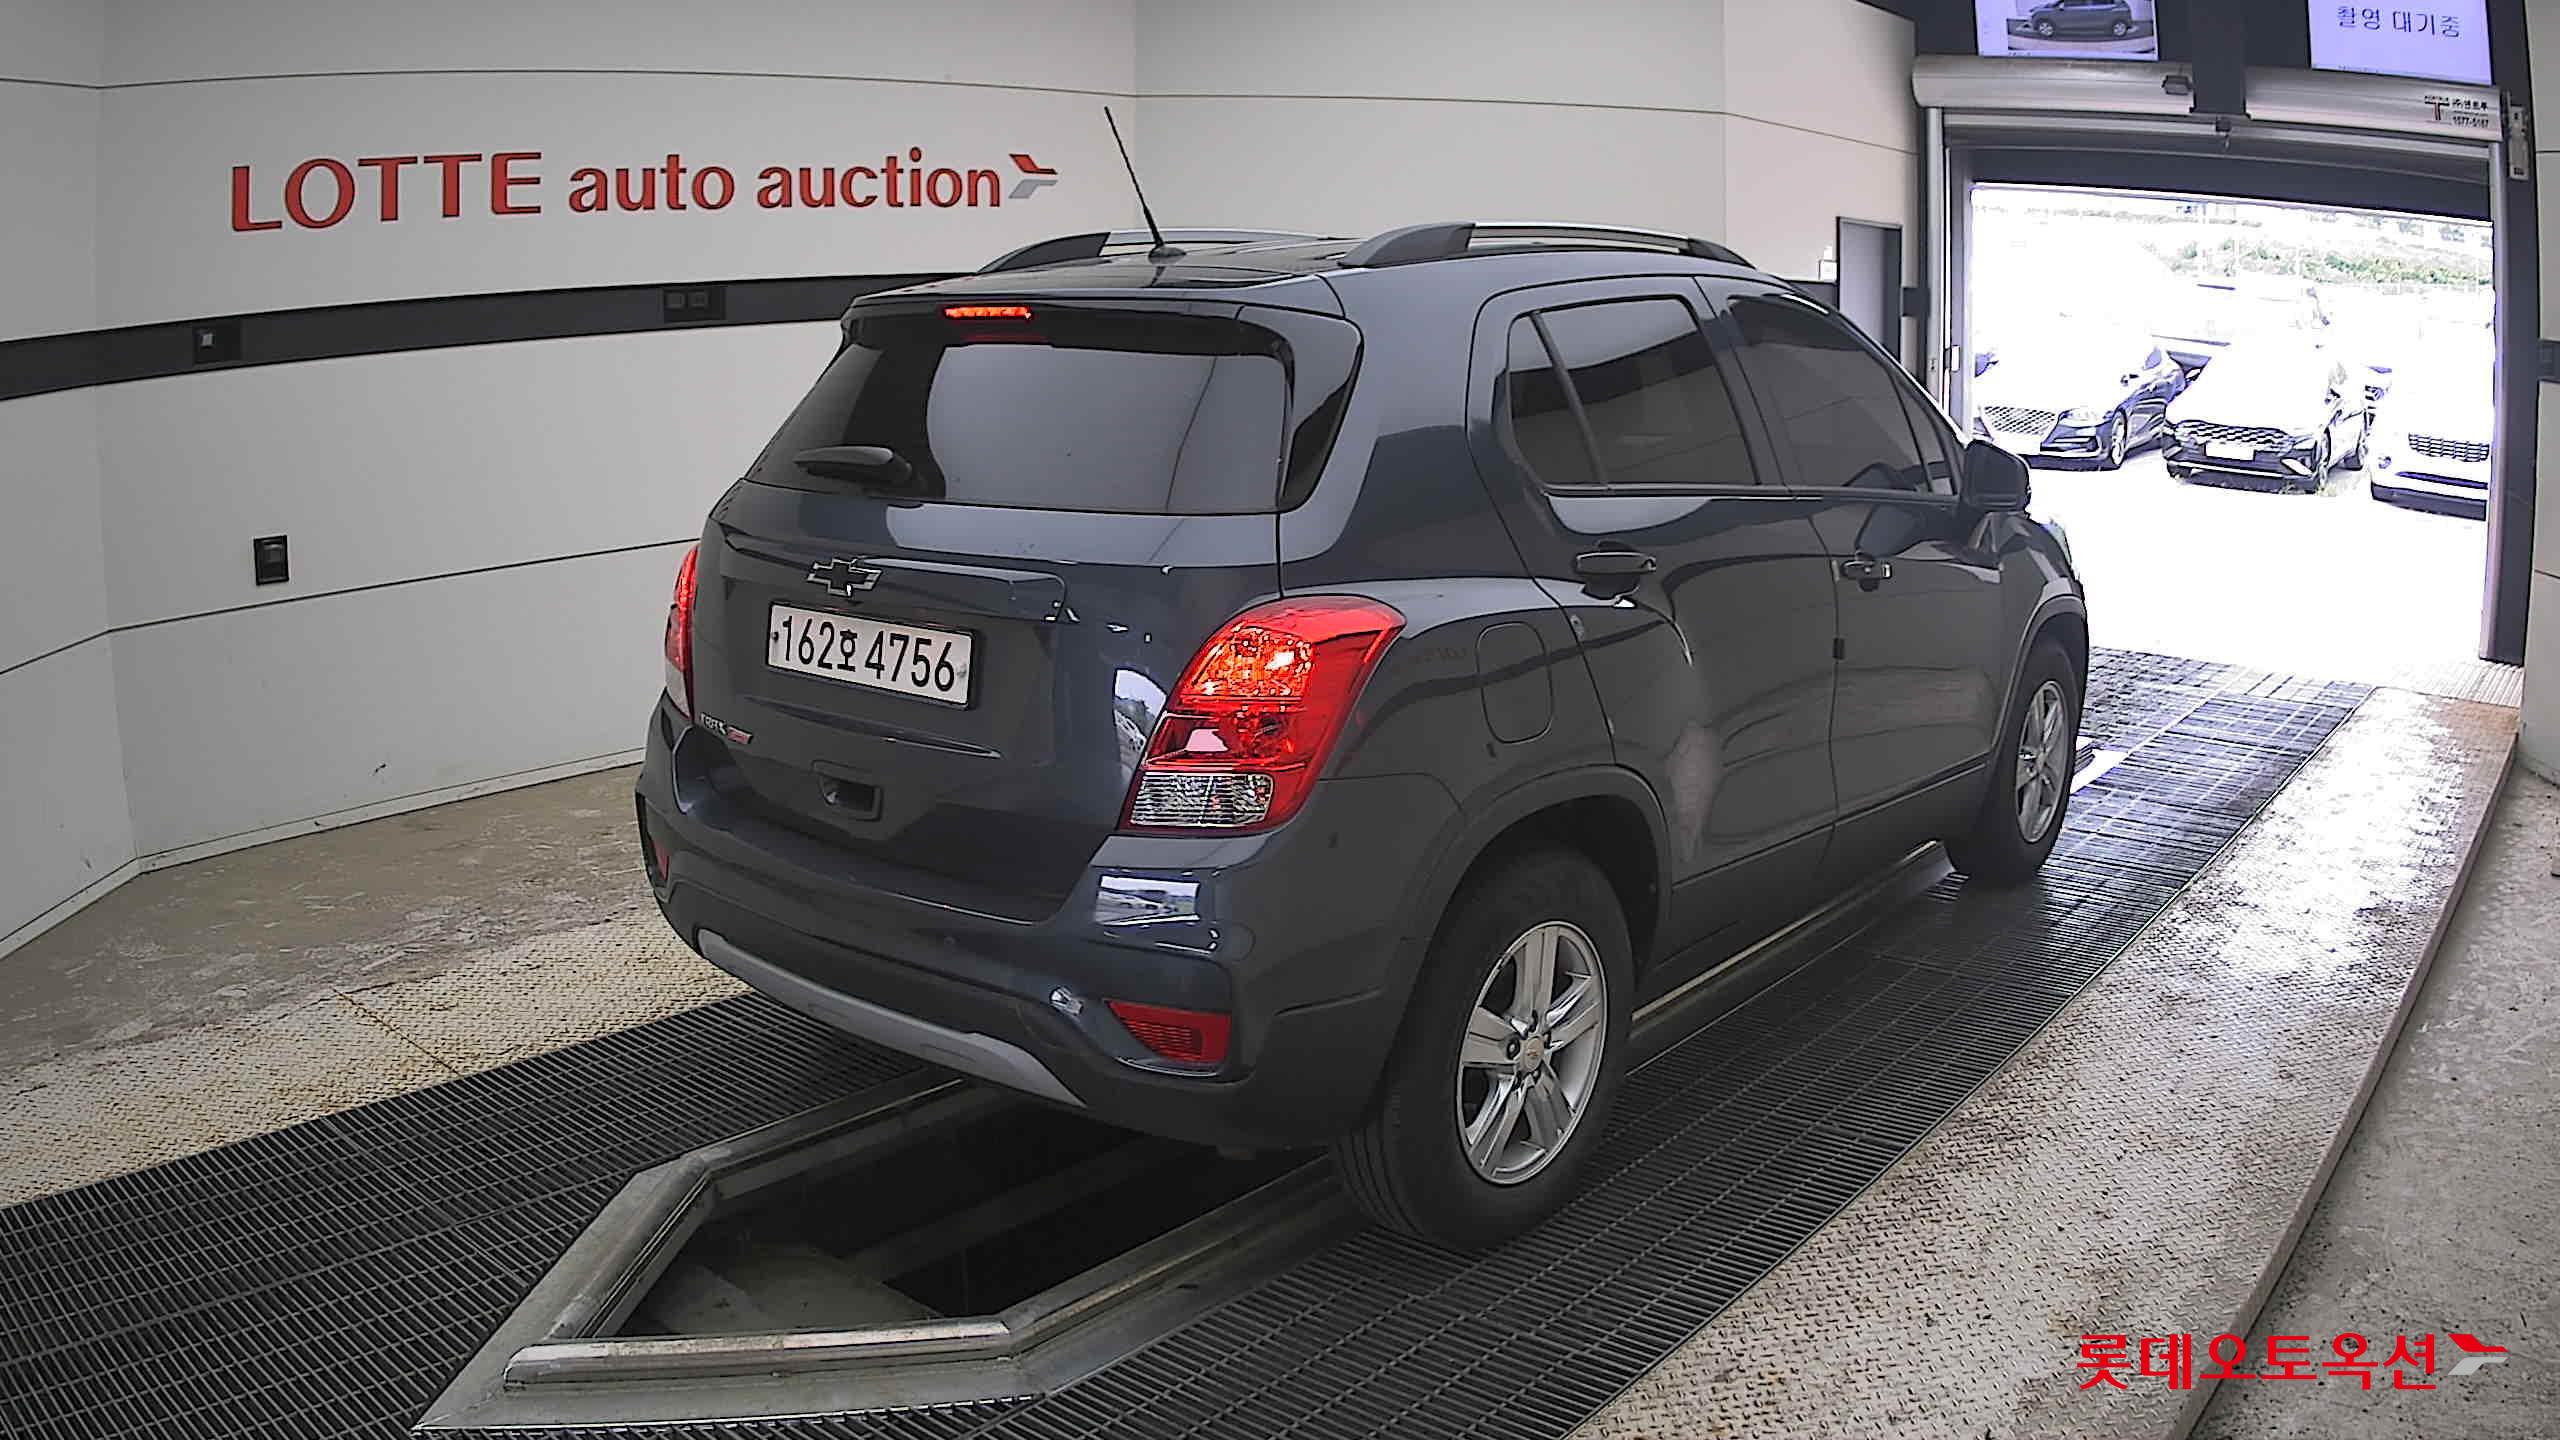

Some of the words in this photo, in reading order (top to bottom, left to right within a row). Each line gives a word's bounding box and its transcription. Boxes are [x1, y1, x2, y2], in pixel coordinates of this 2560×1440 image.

[2337, 6, 2381, 30] 촬영
[2392, 11, 2460, 38] 대기중
[232, 152, 542, 232] LOTTE
[568, 154, 735, 213] auto
[757, 147, 1001, 208] auction
[782, 615, 858, 673] 162호
[865, 631, 955, 692] 4756
